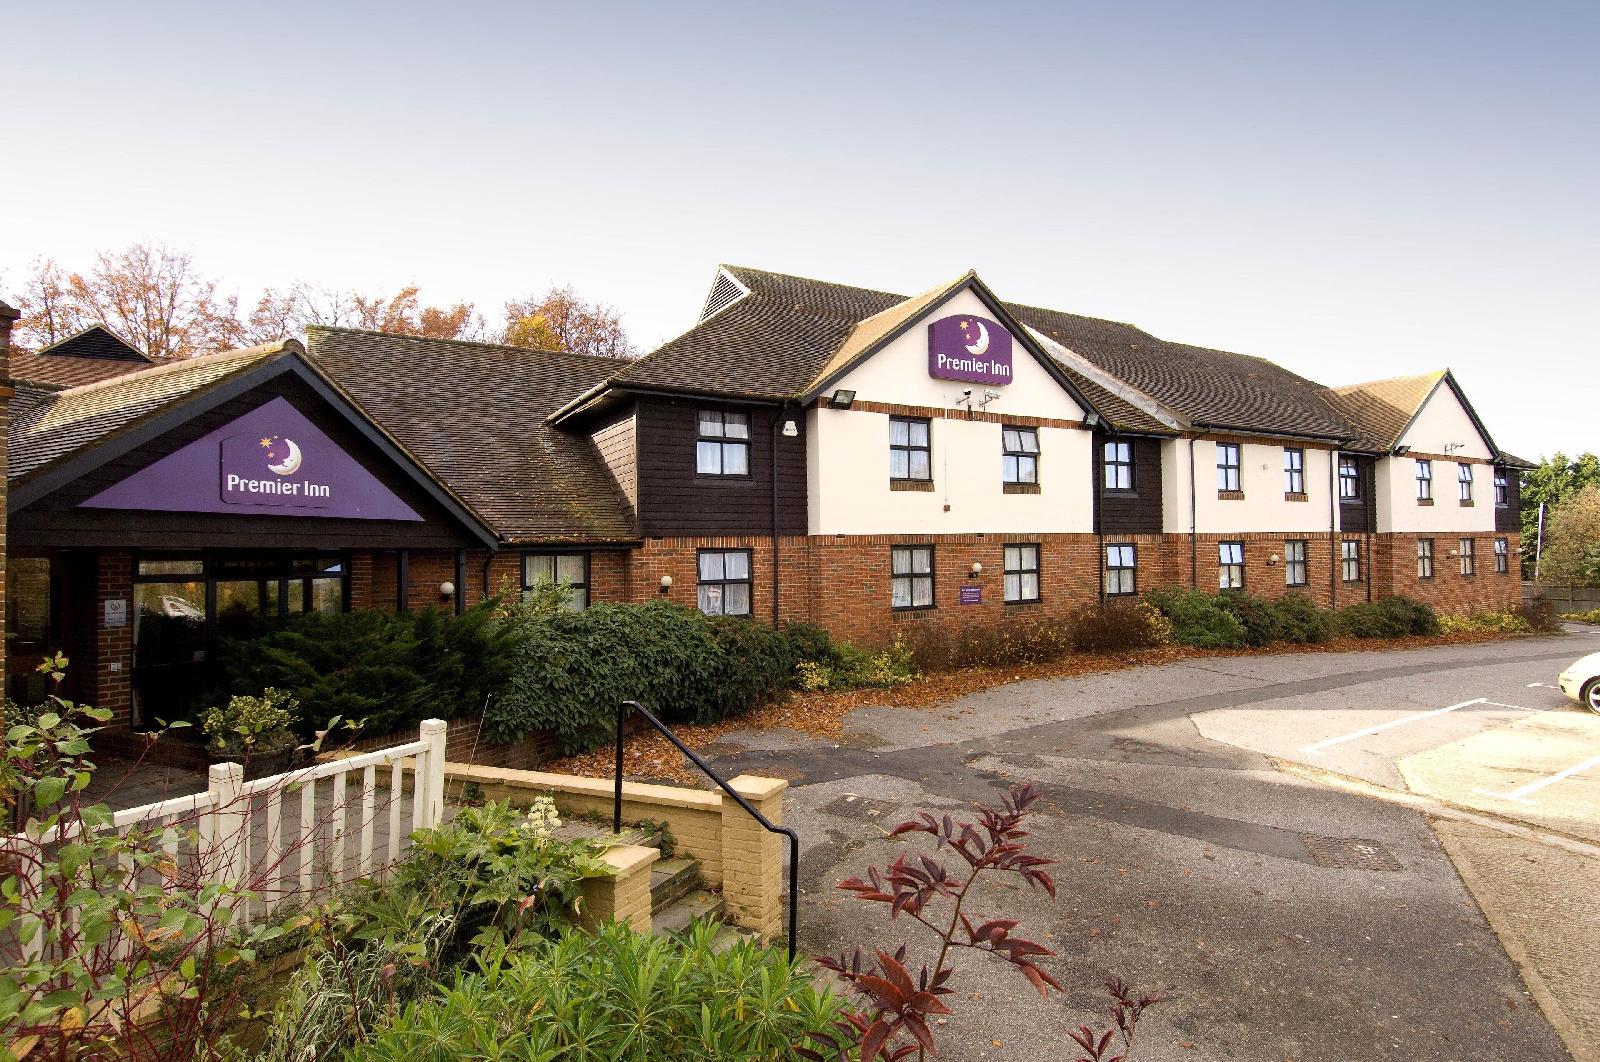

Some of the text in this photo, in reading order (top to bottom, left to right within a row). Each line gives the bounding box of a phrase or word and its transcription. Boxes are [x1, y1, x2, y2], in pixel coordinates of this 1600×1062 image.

[938, 353, 1010, 376] Premier Inn
[227, 474, 330, 497] Premier Inn
